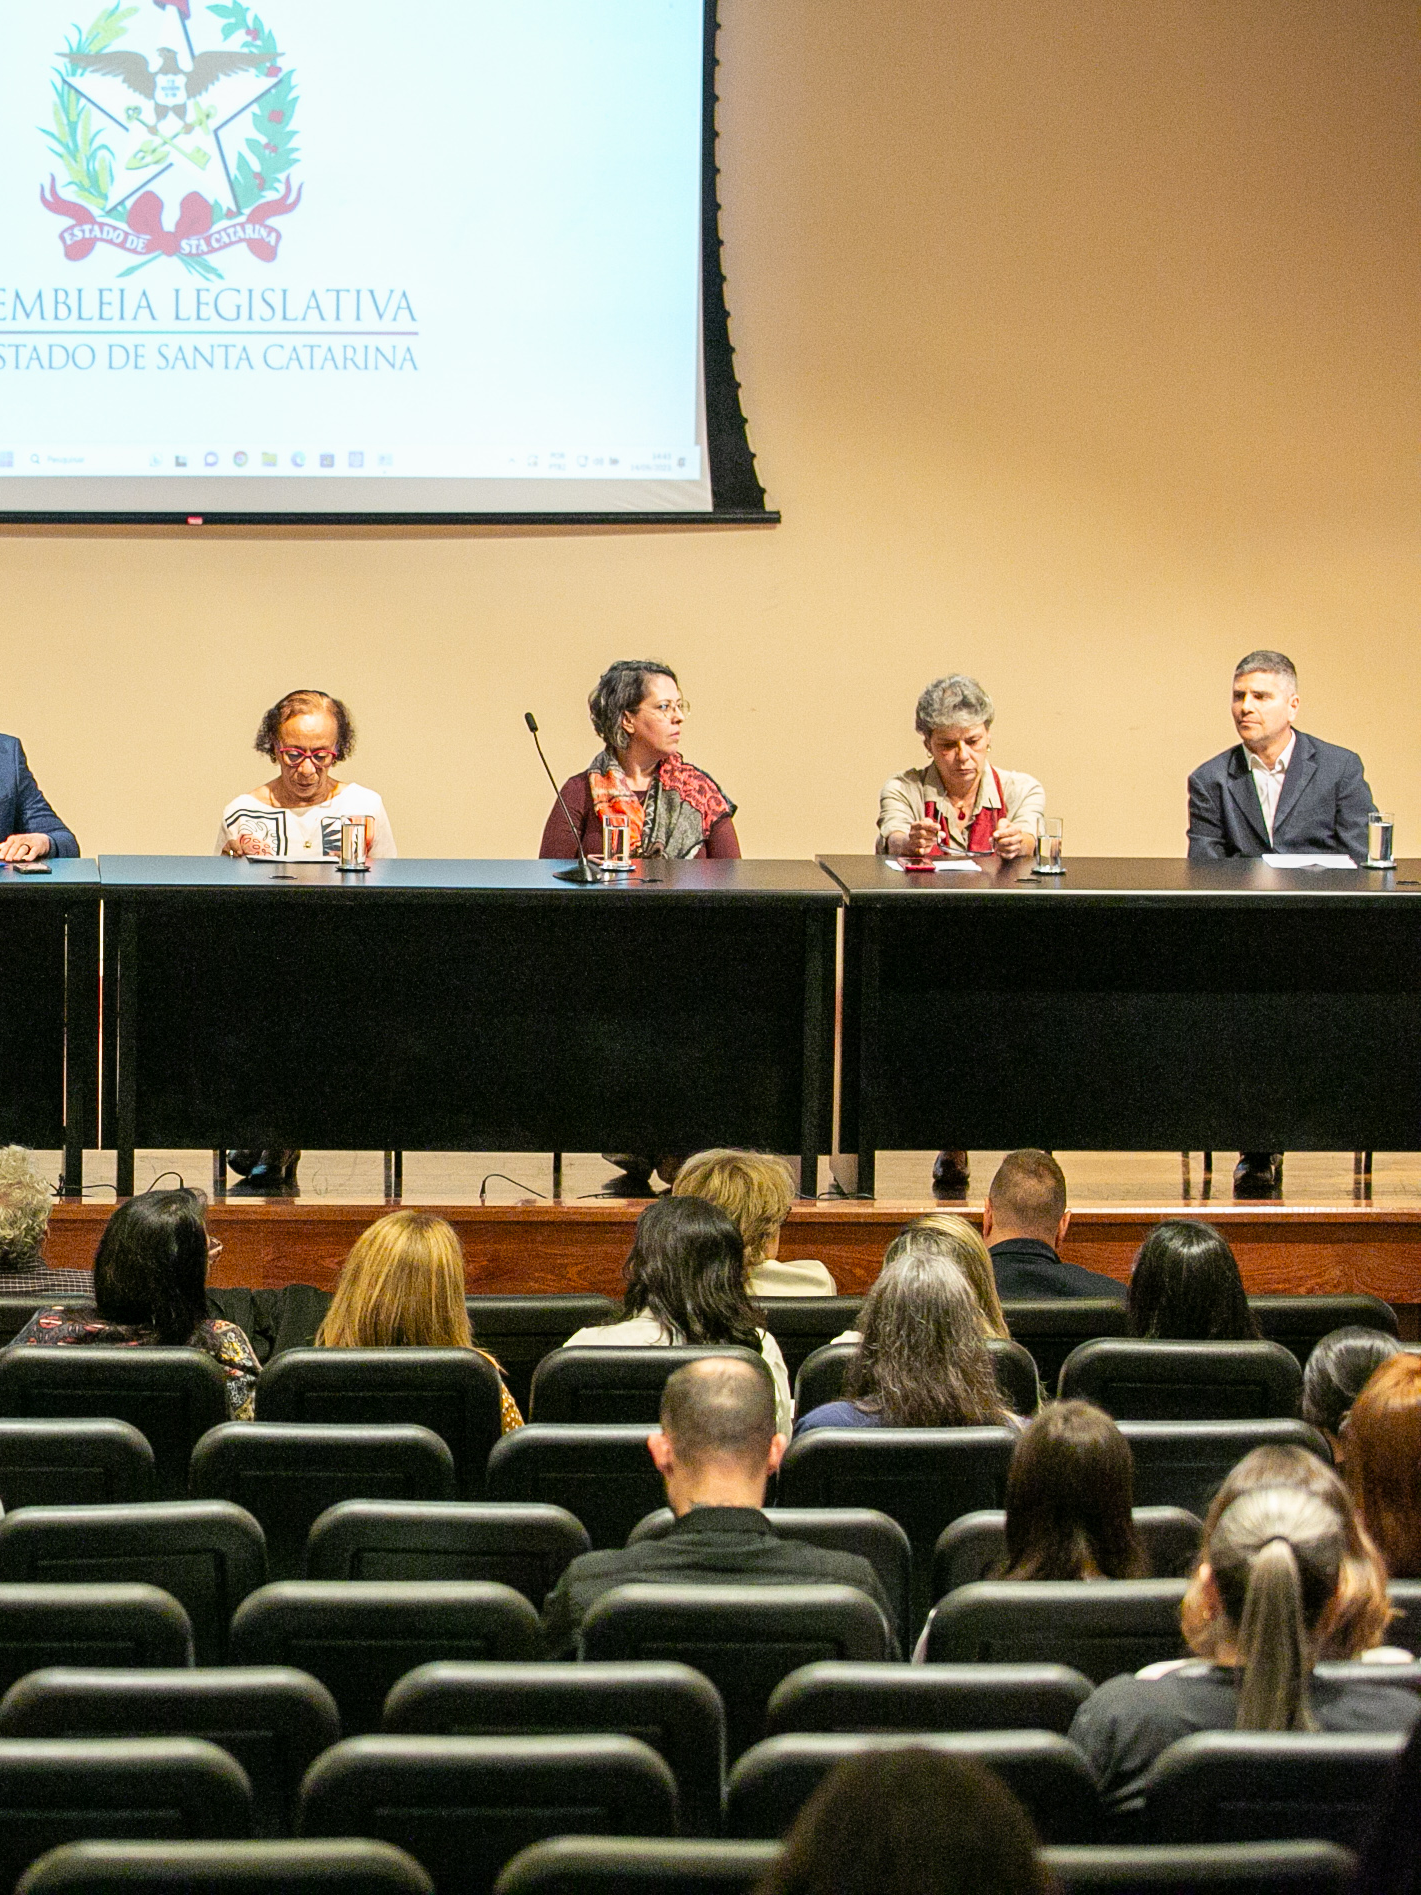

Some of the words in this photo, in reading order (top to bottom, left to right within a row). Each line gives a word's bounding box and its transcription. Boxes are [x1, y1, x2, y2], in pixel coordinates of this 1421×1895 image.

[63, 223, 125, 246] ESTADO
[125, 235, 147, 253] DE
[211, 223, 278, 247] CATARINA
[172, 288, 418, 322] LEGISLATIVA
[107, 343, 147, 371] DE
[156, 343, 255, 371] SANTA
[263, 344, 419, 371] CATARINA
